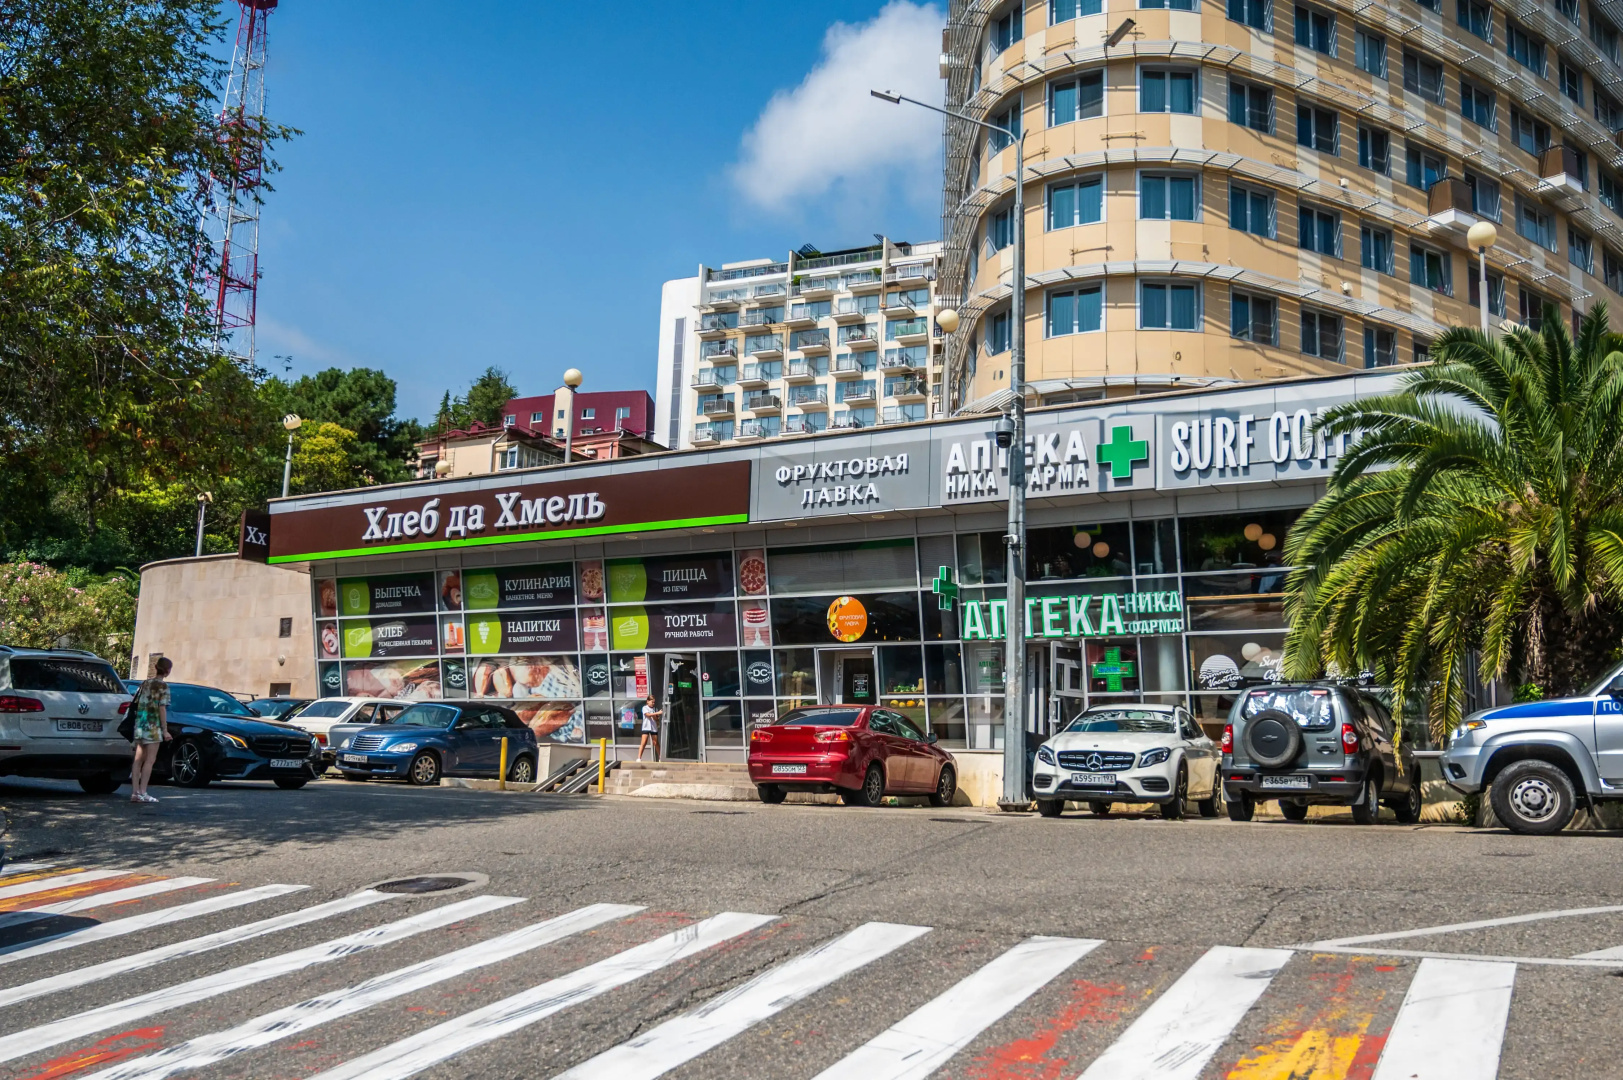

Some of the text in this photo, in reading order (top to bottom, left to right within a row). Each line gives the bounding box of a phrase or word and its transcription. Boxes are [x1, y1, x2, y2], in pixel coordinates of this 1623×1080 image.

[1171, 415, 1255, 472] SURF
[775, 453, 909, 483] ФРУКТОВАЯ
[945, 462, 1089, 494] НИКА АРМА
[801, 482, 879, 505] ЛАВКА
[362, 491, 606, 541] Хлеб да Хмель
[504, 575, 572, 591] КУЛИНАРИЯ
[662, 567, 708, 583] ПИЦЦА
[374, 585, 422, 599] ВЫПЕЧКА
[505, 592, 554, 601] БАНКЕТНОЕ МЕНЮ
[1125, 590, 1182, 613] НИКА
[507, 619, 561, 633] НАПИТКИ
[664, 613, 708, 628] ТОРТЫ
[1128, 618, 1182, 634] ФАРМА
[377, 626, 403, 638] ХЛЕБ
[512, 635, 536, 643] ВАШЕМУ
[664, 629, 714, 639] РУЧНОЙ РАБОТЫ
[1259, 652, 1286, 671] Surf
[592, 671, 606, 679] DC
[752, 668, 768, 677] DC
[1199, 668, 1235, 684] Summer
[1207, 675, 1244, 688] Vacation
